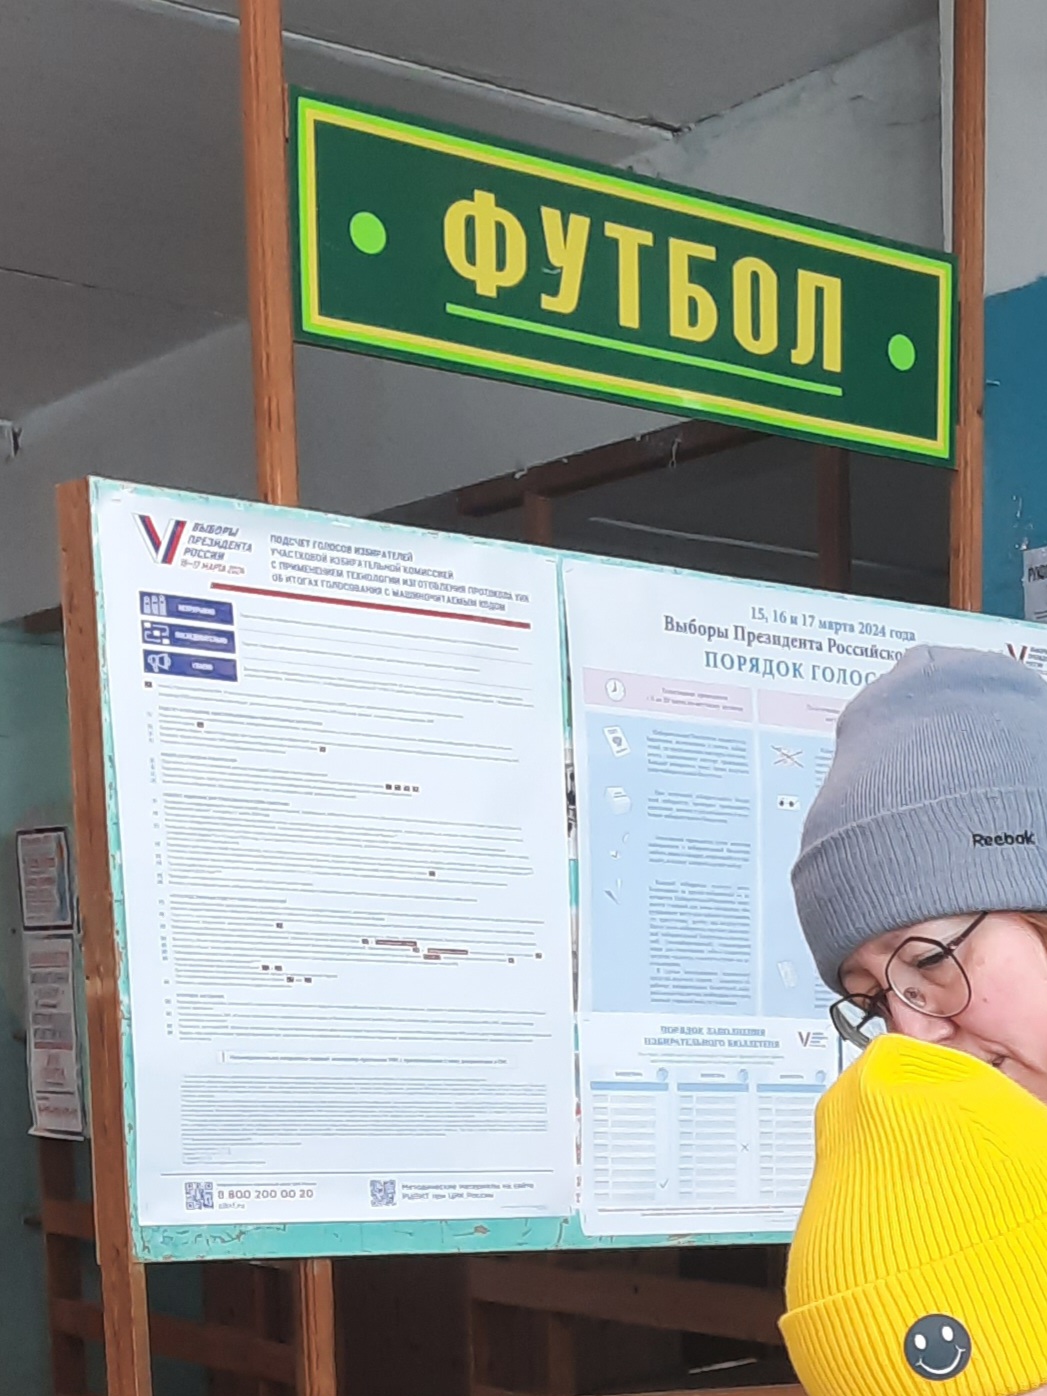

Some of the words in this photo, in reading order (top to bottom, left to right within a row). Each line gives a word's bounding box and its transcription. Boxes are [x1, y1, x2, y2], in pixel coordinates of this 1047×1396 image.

[442, 188, 843, 373] ФУТБОЛ
[191, 521, 240, 537] ВЫБОРЫ
[183, 546, 226, 561] РОССИИ
[187, 534, 253, 553] ПРЕЗИДЕНТА
[270, 534, 311, 548] ПОДСЧЕТ
[312, 540, 352, 555] ГОЛОСОВ
[354, 545, 413, 563] ИЗБИРАТЕЛЕЙ
[270, 547, 328, 564] УЧАСТКОВОЙ
[329, 556, 401, 573] ИЗБИРАТЕЛЬНОЙ
[402, 565, 454, 580] КОМИССИЕЙ
[270, 560, 277, 569] С
[278, 561, 345, 579] ПРИМЕНЕНИЕМ
[271, 573, 284, 583] ОБ
[285, 575, 319, 587] ИТОГАХ
[320, 579, 383, 595] ГОЛОСОВАНИЯ
[750, 606, 769, 623] 15,
[772, 609, 787, 624] 16
[789, 614, 799, 626] и
[801, 612, 816, 628] 17
[818, 618, 856, 635] марта
[858, 621, 887, 638] 2024
[889, 628, 917, 642] года
[663, 614, 730, 642] Выборы
[733, 624, 824, 653] Президента
[827, 637, 908, 662] Российско
[704, 650, 806, 680] ПОРЯДОК
[971, 829, 1036, 848] Reebok
[228, 1189, 252, 1200] 800
[254, 1189, 278, 1199] 200
[280, 1189, 297, 1199] 00
[299, 1188, 314, 1199] 20
